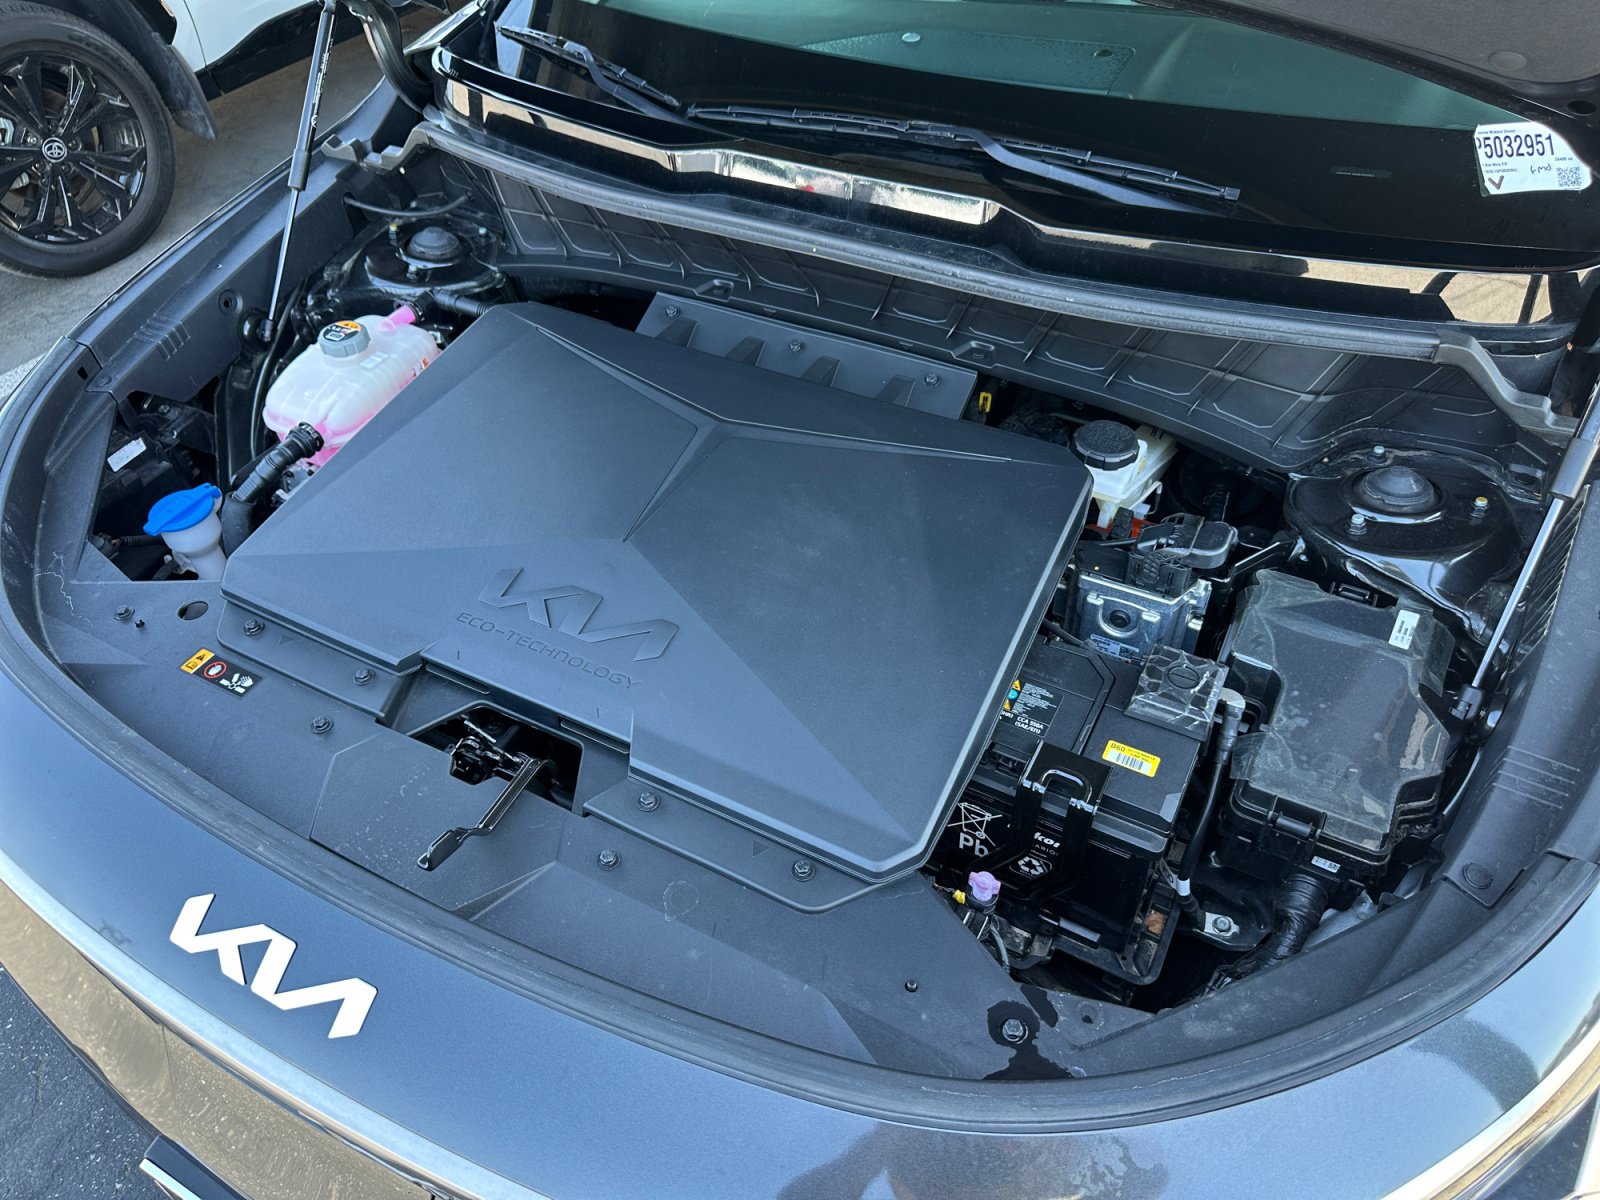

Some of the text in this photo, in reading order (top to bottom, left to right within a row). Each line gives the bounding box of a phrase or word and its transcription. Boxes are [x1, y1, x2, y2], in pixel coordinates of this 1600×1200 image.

[478, 567, 679, 662] KIA
[455, 612, 642, 689] ECO-TECHNOLOGY
[1016, 716, 1029, 725] CCA
[1110, 743, 1126, 752] B60
[959, 832, 989, 857] Pb
[169, 893, 379, 1039] KIA
